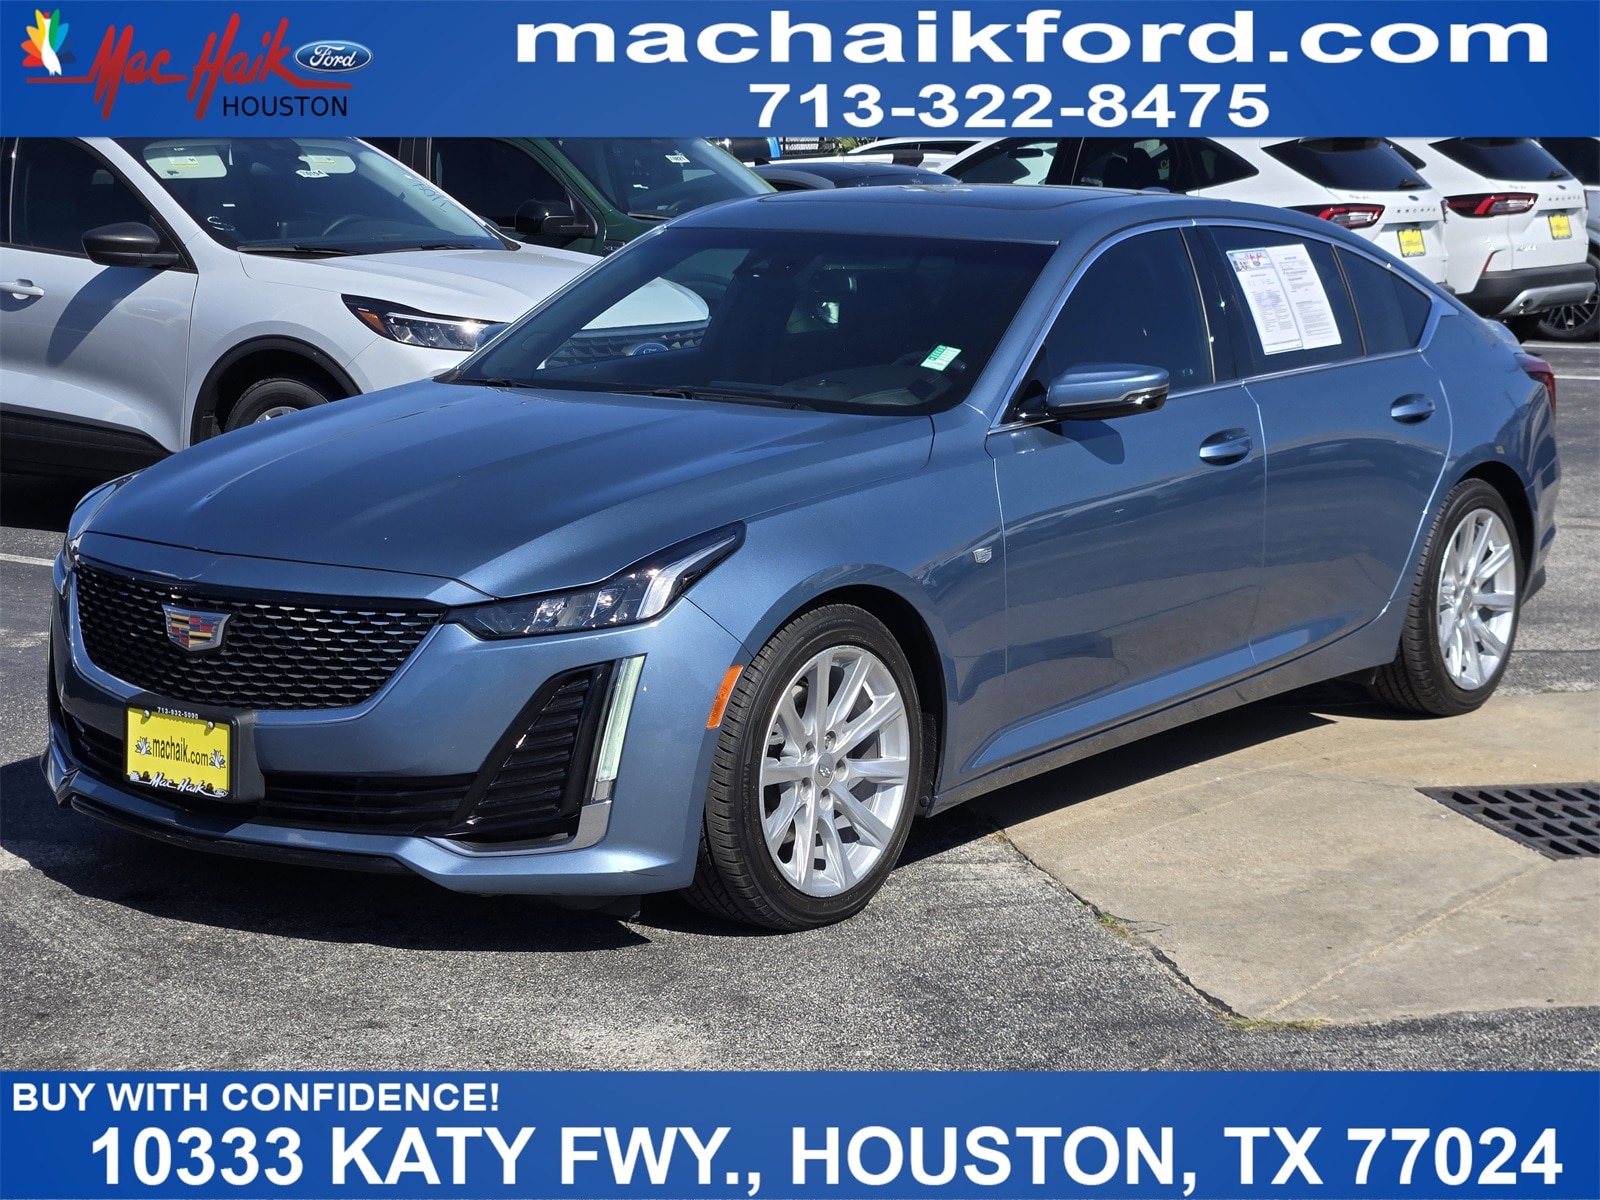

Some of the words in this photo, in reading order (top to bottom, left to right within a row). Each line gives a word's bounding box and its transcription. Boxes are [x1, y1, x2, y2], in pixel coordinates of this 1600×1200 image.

[152, 735, 209, 767] machaik.com
[149, 771, 177, 789] Mac
[176, 776, 210, 797] Haik
